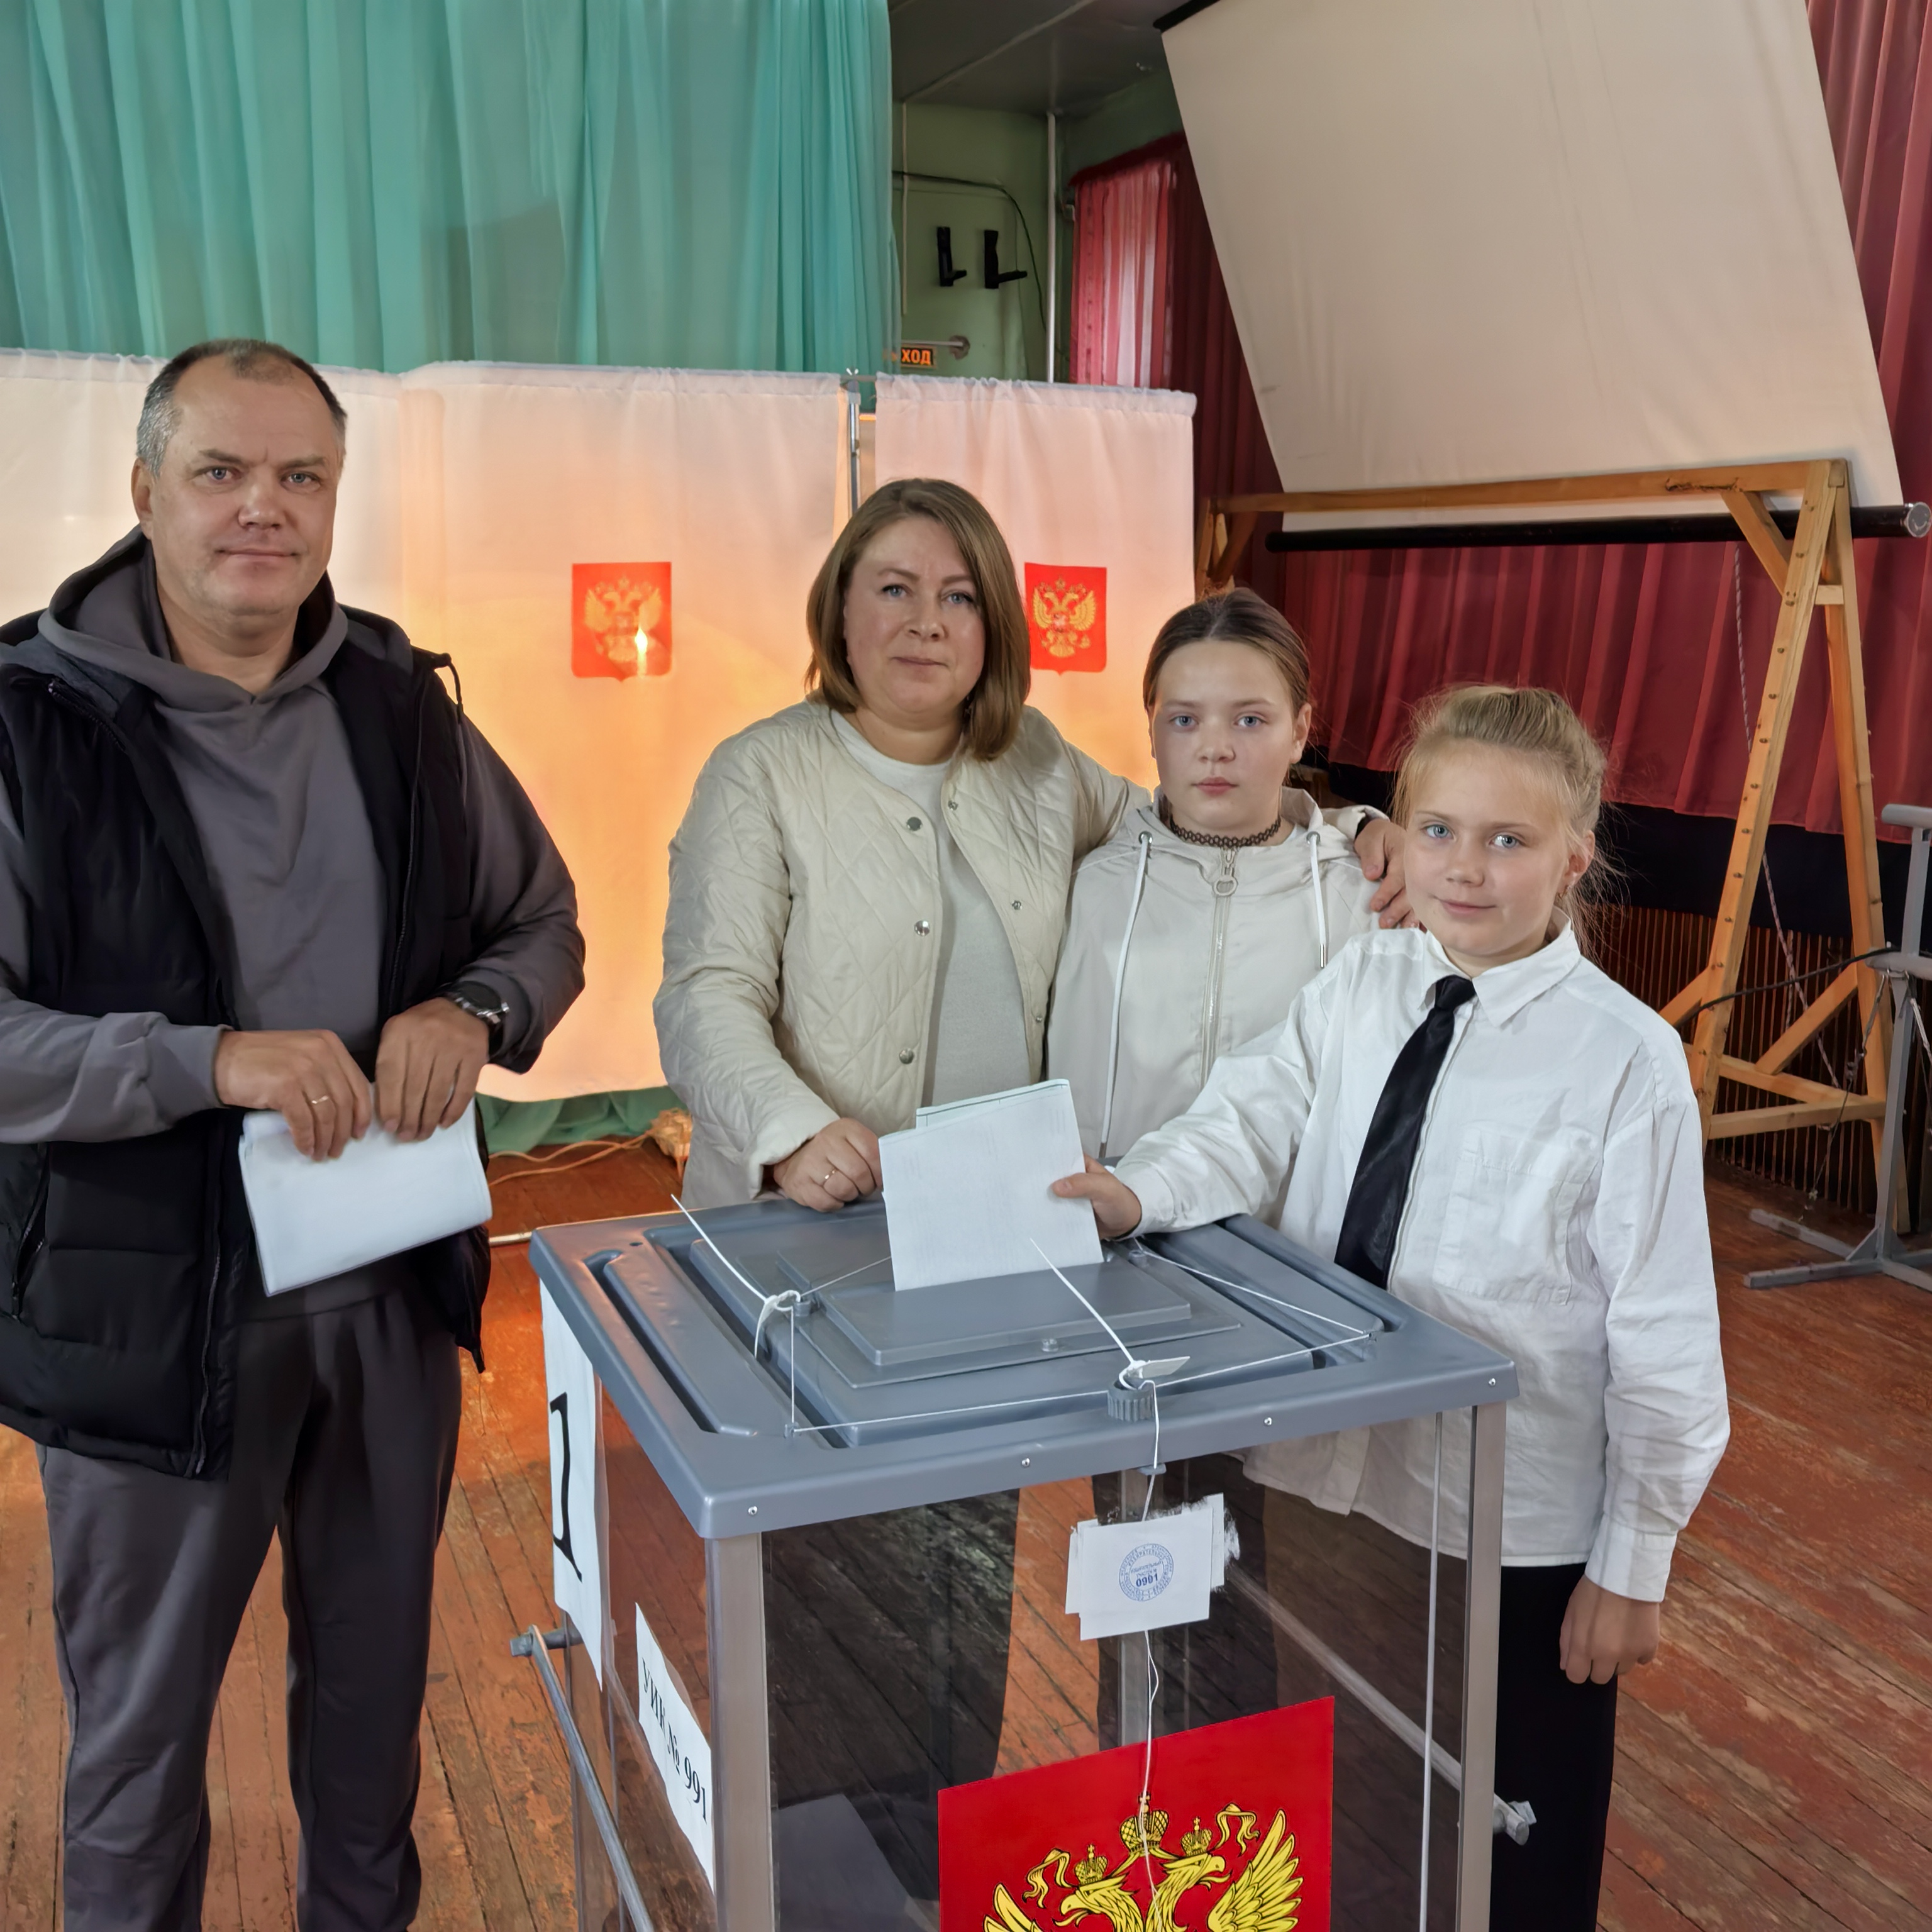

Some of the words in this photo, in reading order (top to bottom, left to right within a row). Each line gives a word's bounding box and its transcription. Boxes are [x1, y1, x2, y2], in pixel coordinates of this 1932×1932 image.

[883, 348, 931, 365] ХОД
[641, 1657, 666, 1740] УИК
[667, 1721, 680, 1775] №
[684, 1757, 707, 1824] 991
